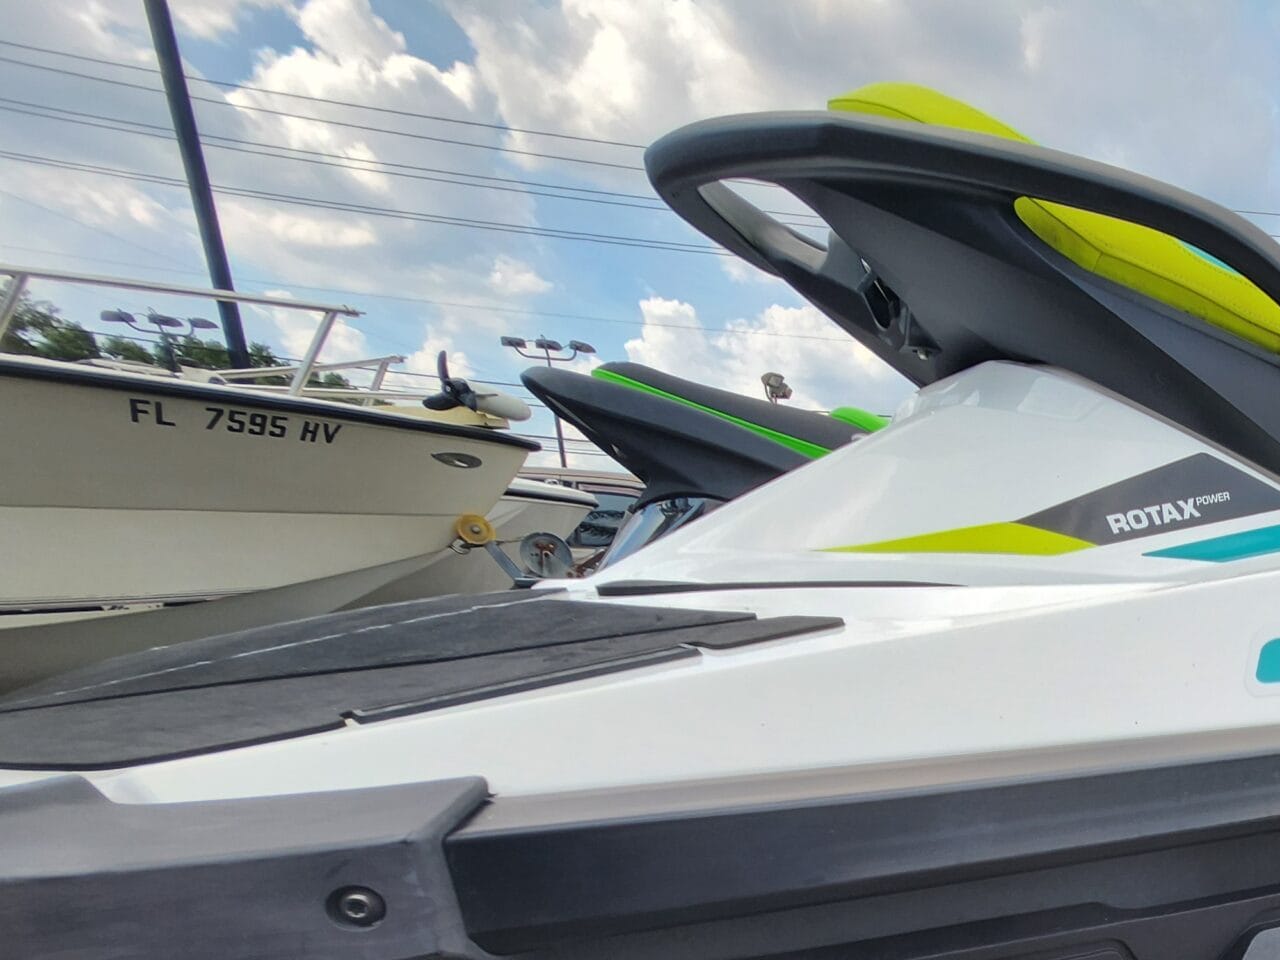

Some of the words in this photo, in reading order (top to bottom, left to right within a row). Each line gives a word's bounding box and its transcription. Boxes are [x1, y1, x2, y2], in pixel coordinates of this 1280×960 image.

[129, 398, 177, 427] FL
[205, 407, 288, 438] 7595
[300, 420, 343, 444] HV
[1105, 497, 1202, 535] ROTAX
[1195, 491, 1231, 507] POWER
